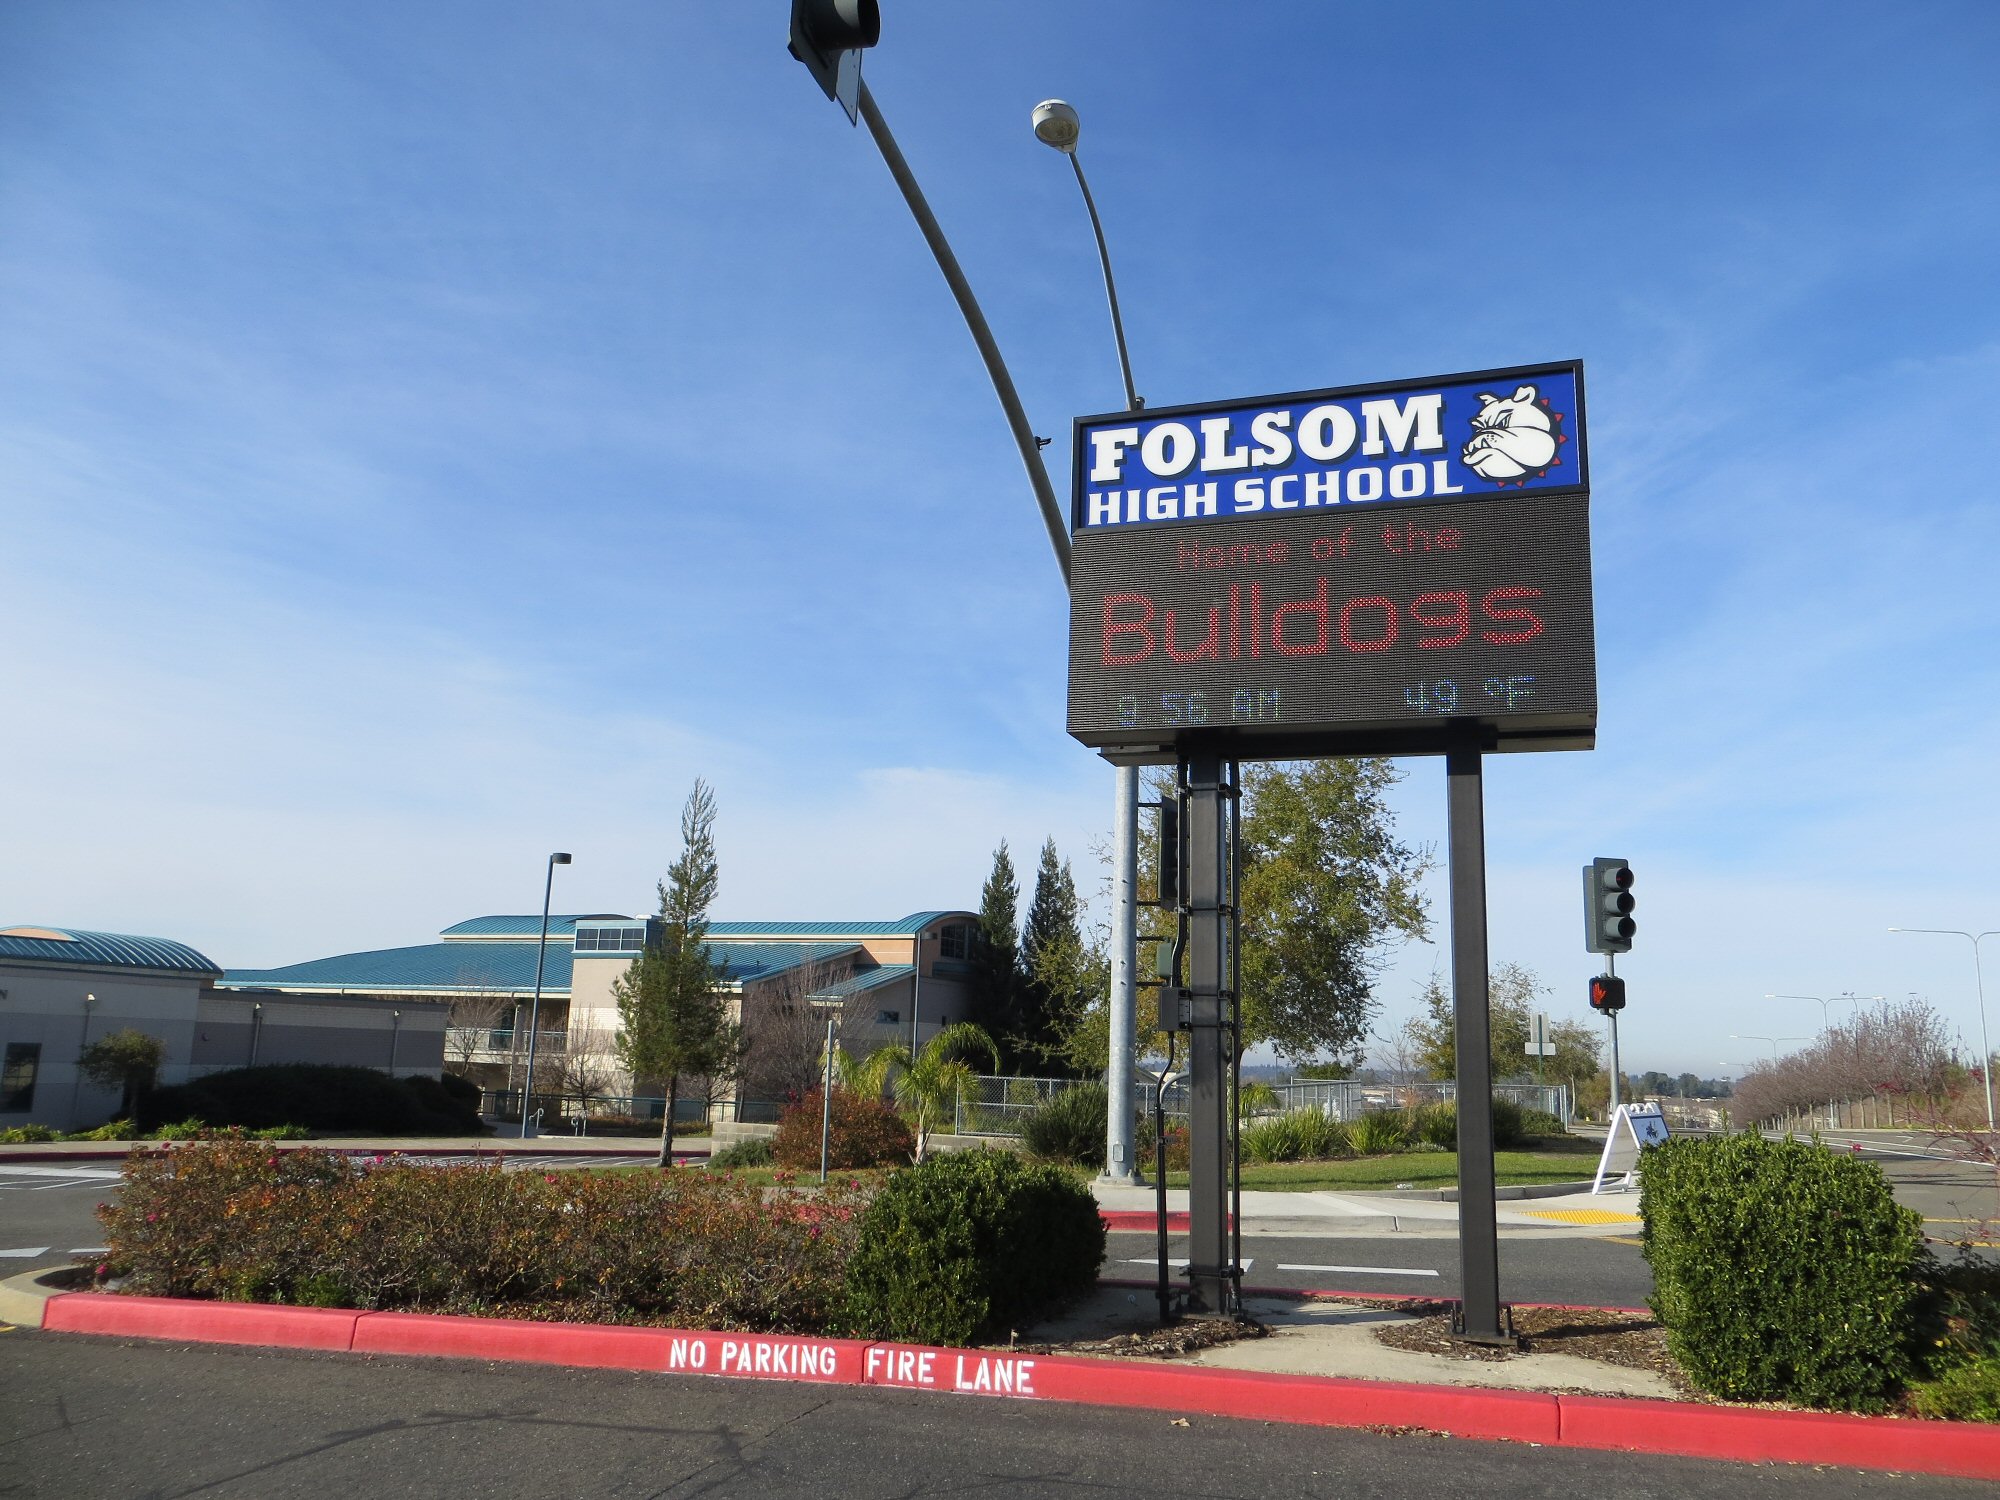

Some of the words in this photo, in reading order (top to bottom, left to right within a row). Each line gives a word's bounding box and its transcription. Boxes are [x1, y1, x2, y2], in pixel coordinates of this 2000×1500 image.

[1090, 393, 1447, 483] FOLSOM
[1088, 481, 1219, 526] HIGH
[1234, 460, 1464, 513] SCHOOL
[1178, 539, 1290, 571] Home
[1311, 526, 1355, 560] of
[1380, 521, 1463, 554] the
[1102, 575, 1544, 666] Bulldogs
[1231, 687, 1281, 723] AM
[1403, 679, 1458, 714] 49
[669, 1337, 707, 1369] NO
[720, 1340, 837, 1376] PARKING
[867, 1347, 936, 1383] FIRE
[955, 1355, 1035, 1393] LANE
